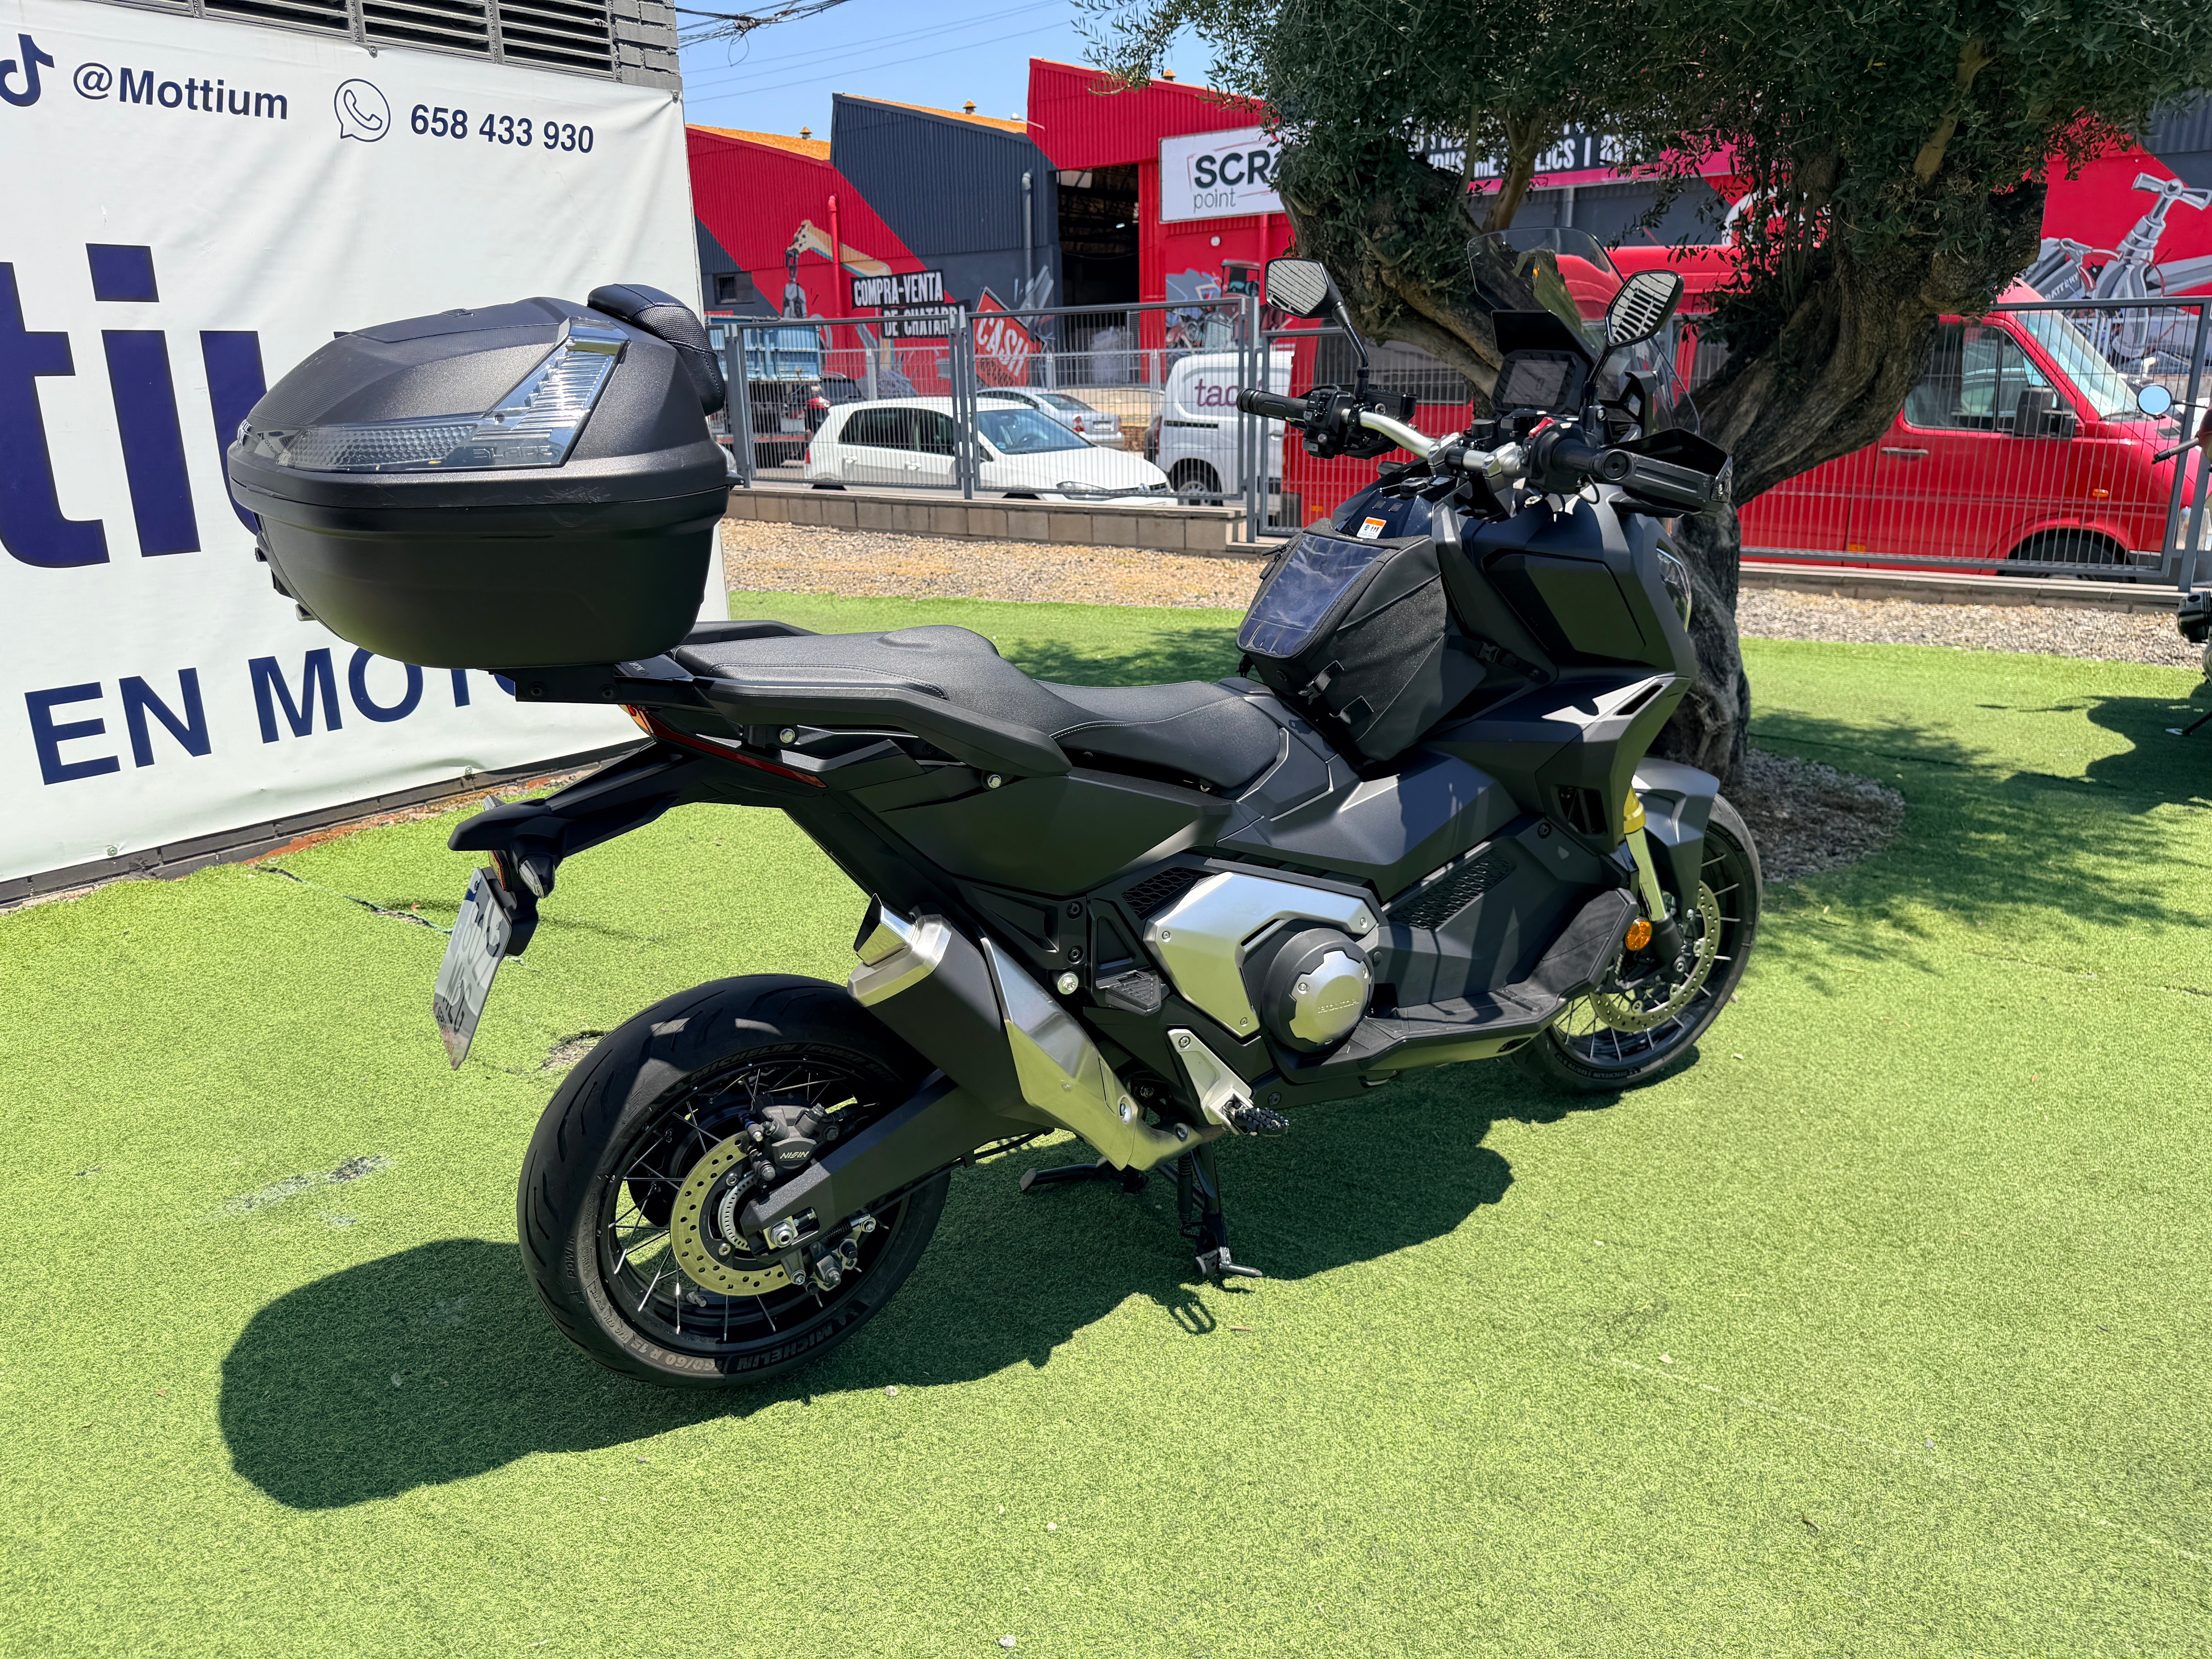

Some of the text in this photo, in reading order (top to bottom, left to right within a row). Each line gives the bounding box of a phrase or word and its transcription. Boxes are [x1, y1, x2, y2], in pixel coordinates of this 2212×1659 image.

[73, 62, 288, 119] @Mottium
[411, 104, 594, 153] 658 433 930
[1195, 150, 1279, 189] SCR
[1194, 188, 1236, 214] point
[854, 271, 944, 307] COMPRA-VENTA
[884, 309, 899, 337] DE
[977, 309, 1029, 377] CASH
[1195, 378, 1262, 406] tac
[25, 647, 515, 785] EN MO
[690, 1044, 799, 1082] MICHELIN
